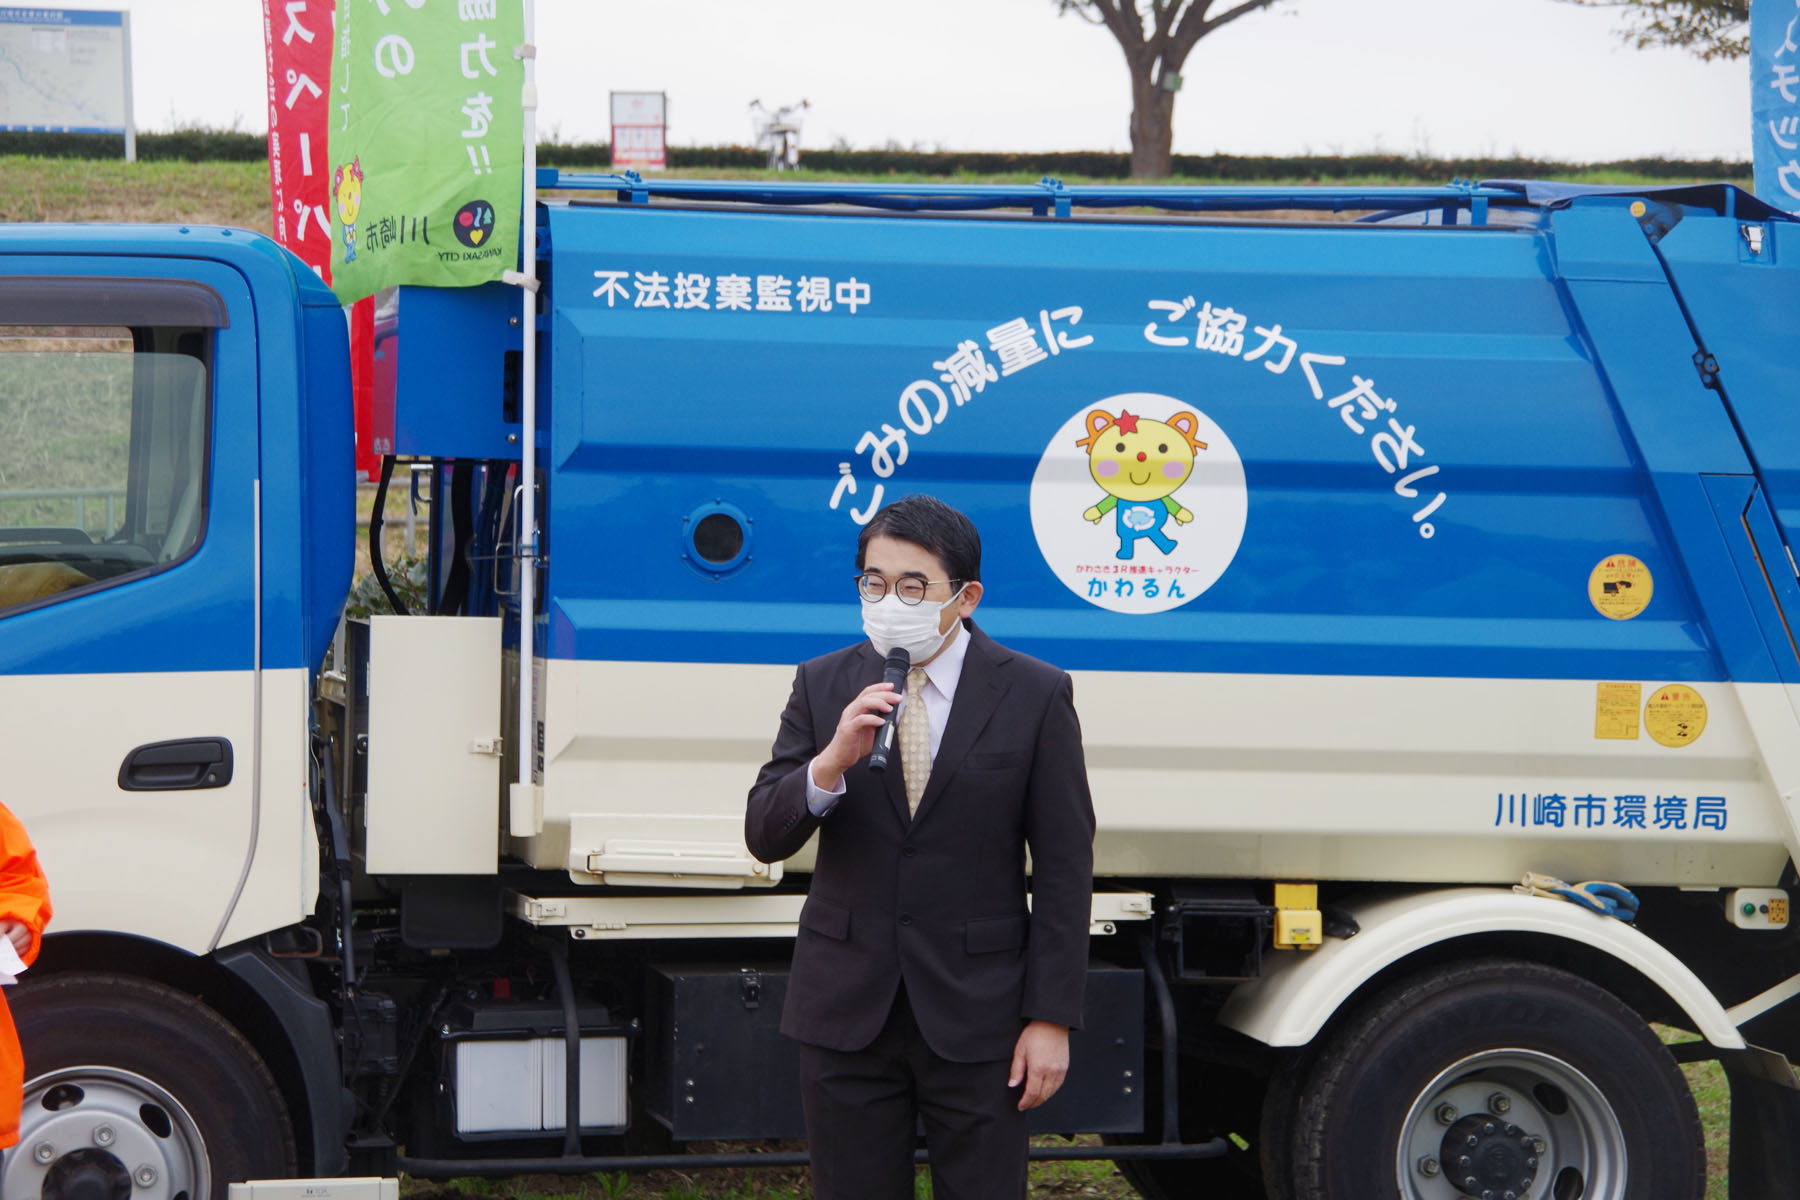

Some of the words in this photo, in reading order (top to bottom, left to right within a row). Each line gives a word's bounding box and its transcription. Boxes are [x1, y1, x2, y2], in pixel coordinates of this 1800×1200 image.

[593, 271, 871, 314] 不法投棄監視中
[829, 306, 1094, 525] ごみの減量に
[1144, 295, 1447, 539] ご協力ください。
[1088, 577, 1186, 598] かわるん
[1495, 793, 1727, 830] 川崎市環境局
